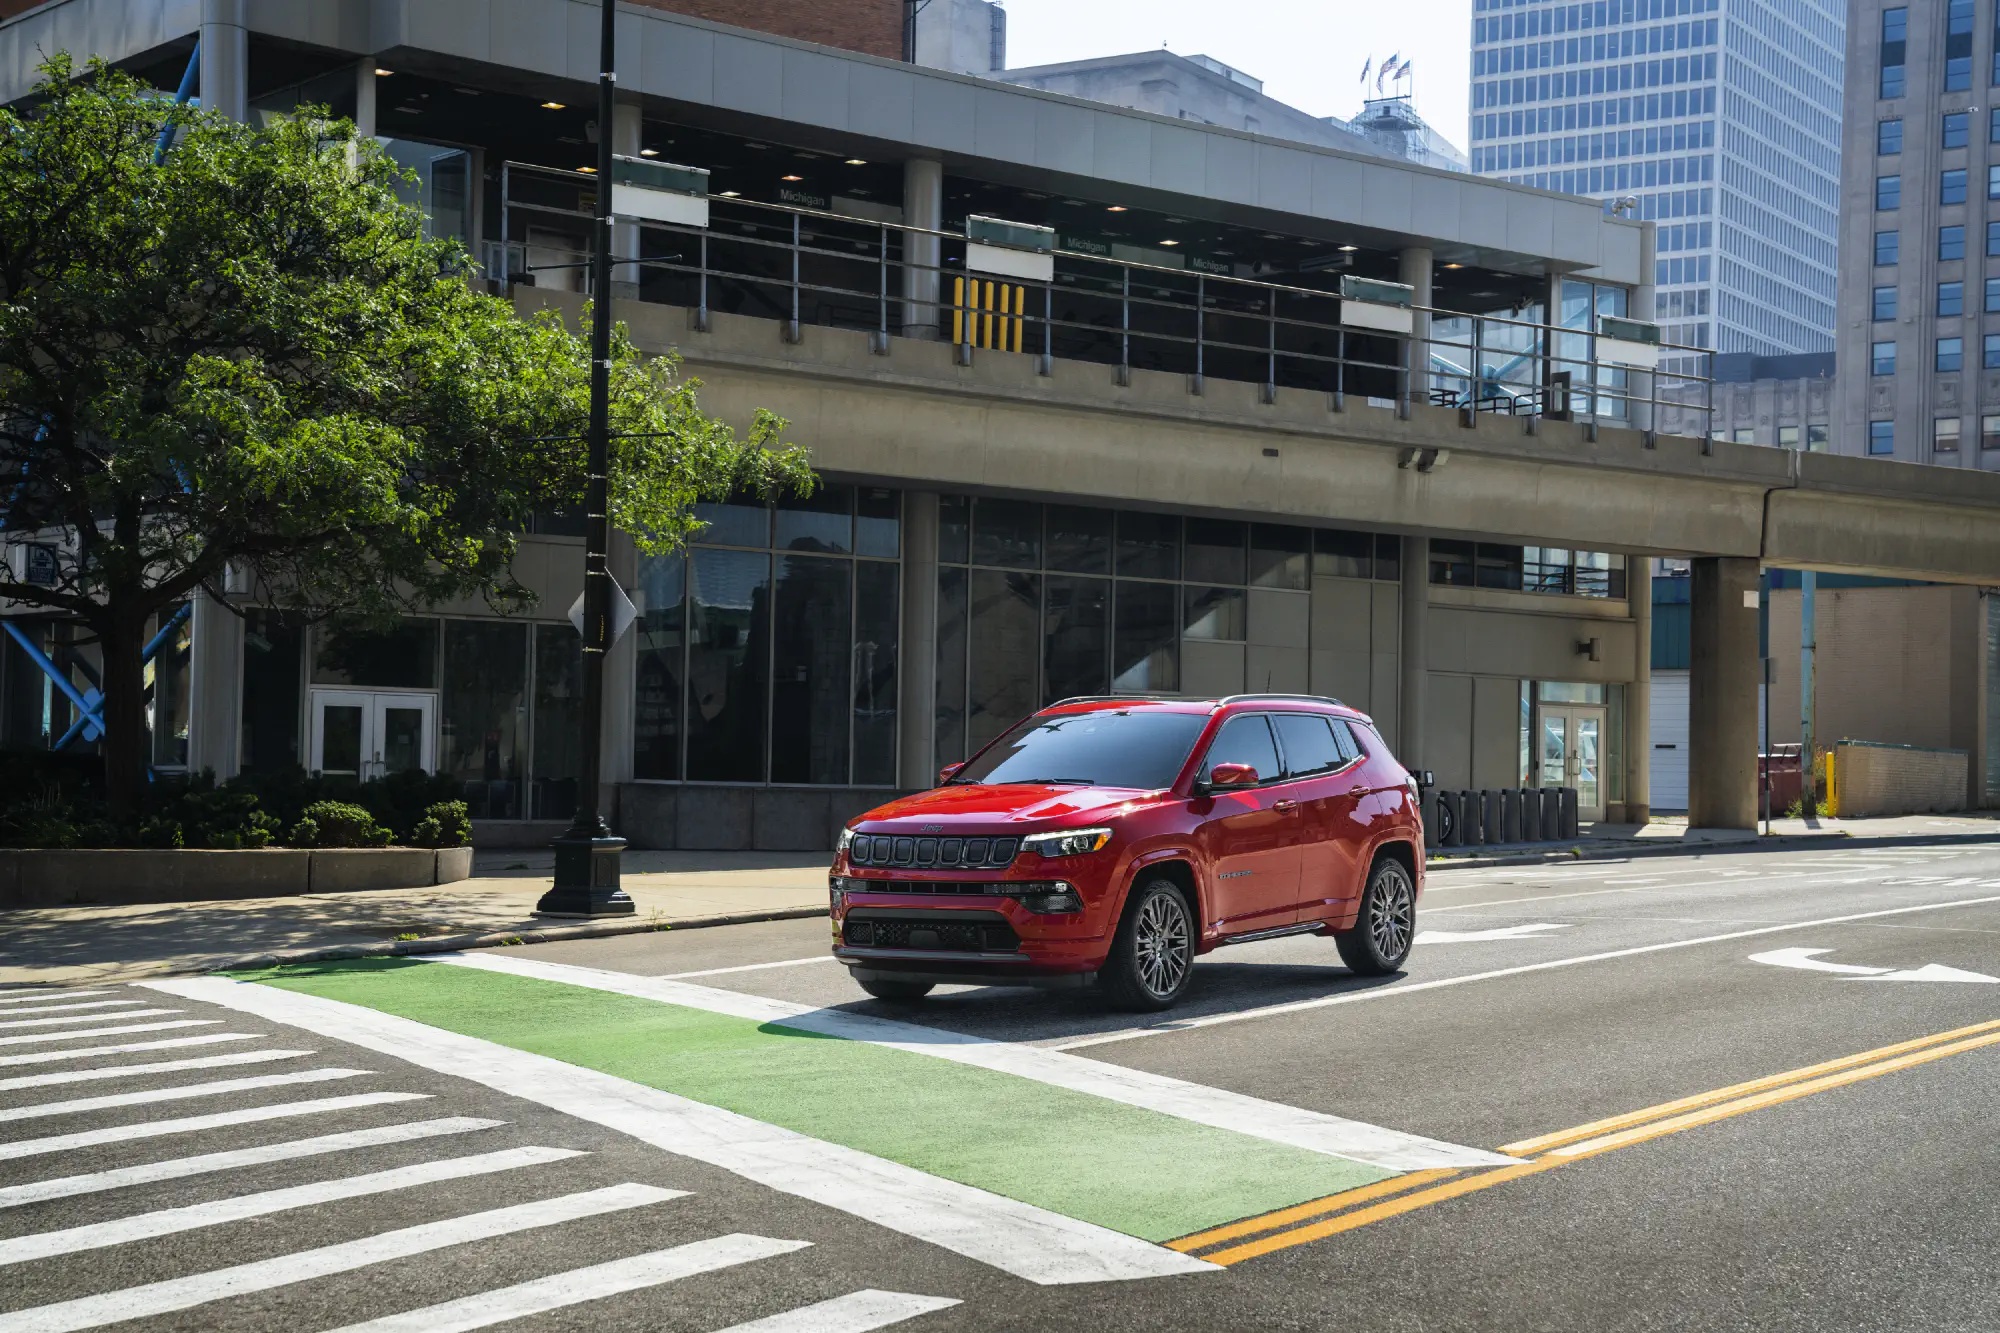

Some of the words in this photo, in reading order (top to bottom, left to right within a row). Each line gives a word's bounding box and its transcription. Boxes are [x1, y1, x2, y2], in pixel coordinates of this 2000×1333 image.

[780, 189, 825, 206] Michigan
[1068, 237, 1106, 252] Michigan
[1193, 257, 1229, 273] Michigan
[921, 824, 943, 833] Jeep
